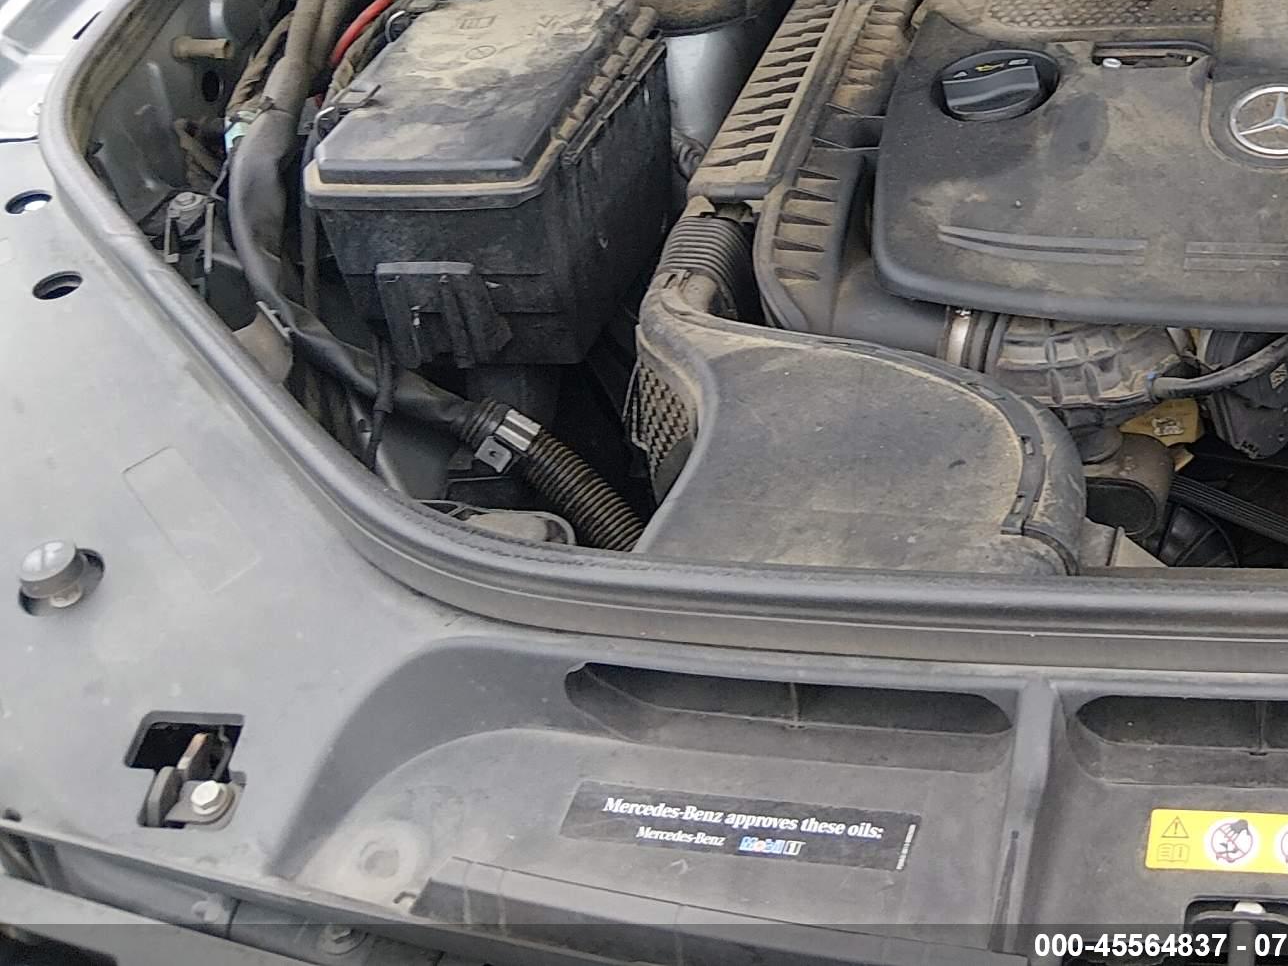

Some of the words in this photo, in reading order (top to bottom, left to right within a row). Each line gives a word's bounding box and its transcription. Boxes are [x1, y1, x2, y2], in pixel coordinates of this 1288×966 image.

[602, 797, 724, 823] Mercedes-Benz
[724, 812, 798, 830] approves
[800, 817, 848, 836] these
[848, 822, 884, 840] oils:
[635, 826, 726, 847] Mercedes-Benz
[739, 836, 785, 854] Mobil
